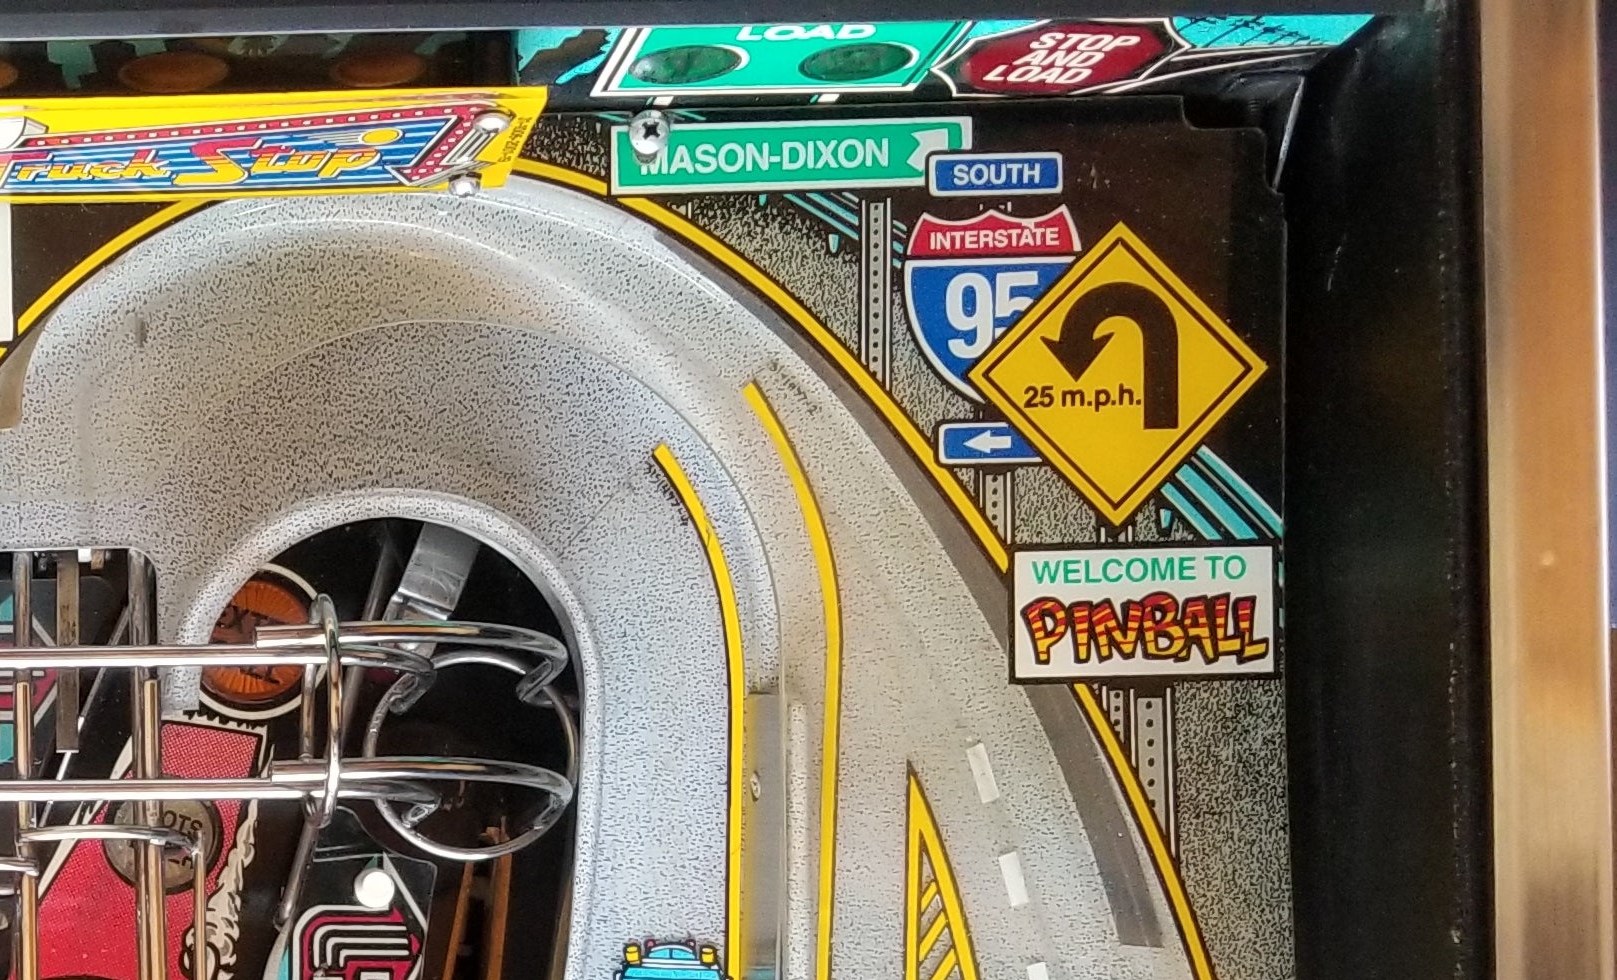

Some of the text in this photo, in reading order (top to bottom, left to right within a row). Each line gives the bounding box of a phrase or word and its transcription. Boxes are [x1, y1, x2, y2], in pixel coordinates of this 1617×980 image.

[736, 24, 877, 41] LOAD
[1029, 32, 1141, 52] STOP
[1011, 49, 1106, 68] AND
[982, 65, 1093, 84] LOAD
[172, 137, 382, 186] Stop
[640, 138, 889, 176] MASON-DIXON
[952, 162, 1041, 187] SOUTH
[929, 226, 1061, 250] INTERSTATE
[1023, 384, 1143, 413] 25 m.p.h.
[1031, 555, 1248, 585] WELCOME TO
[1019, 591, 1270, 666] PINBALL
